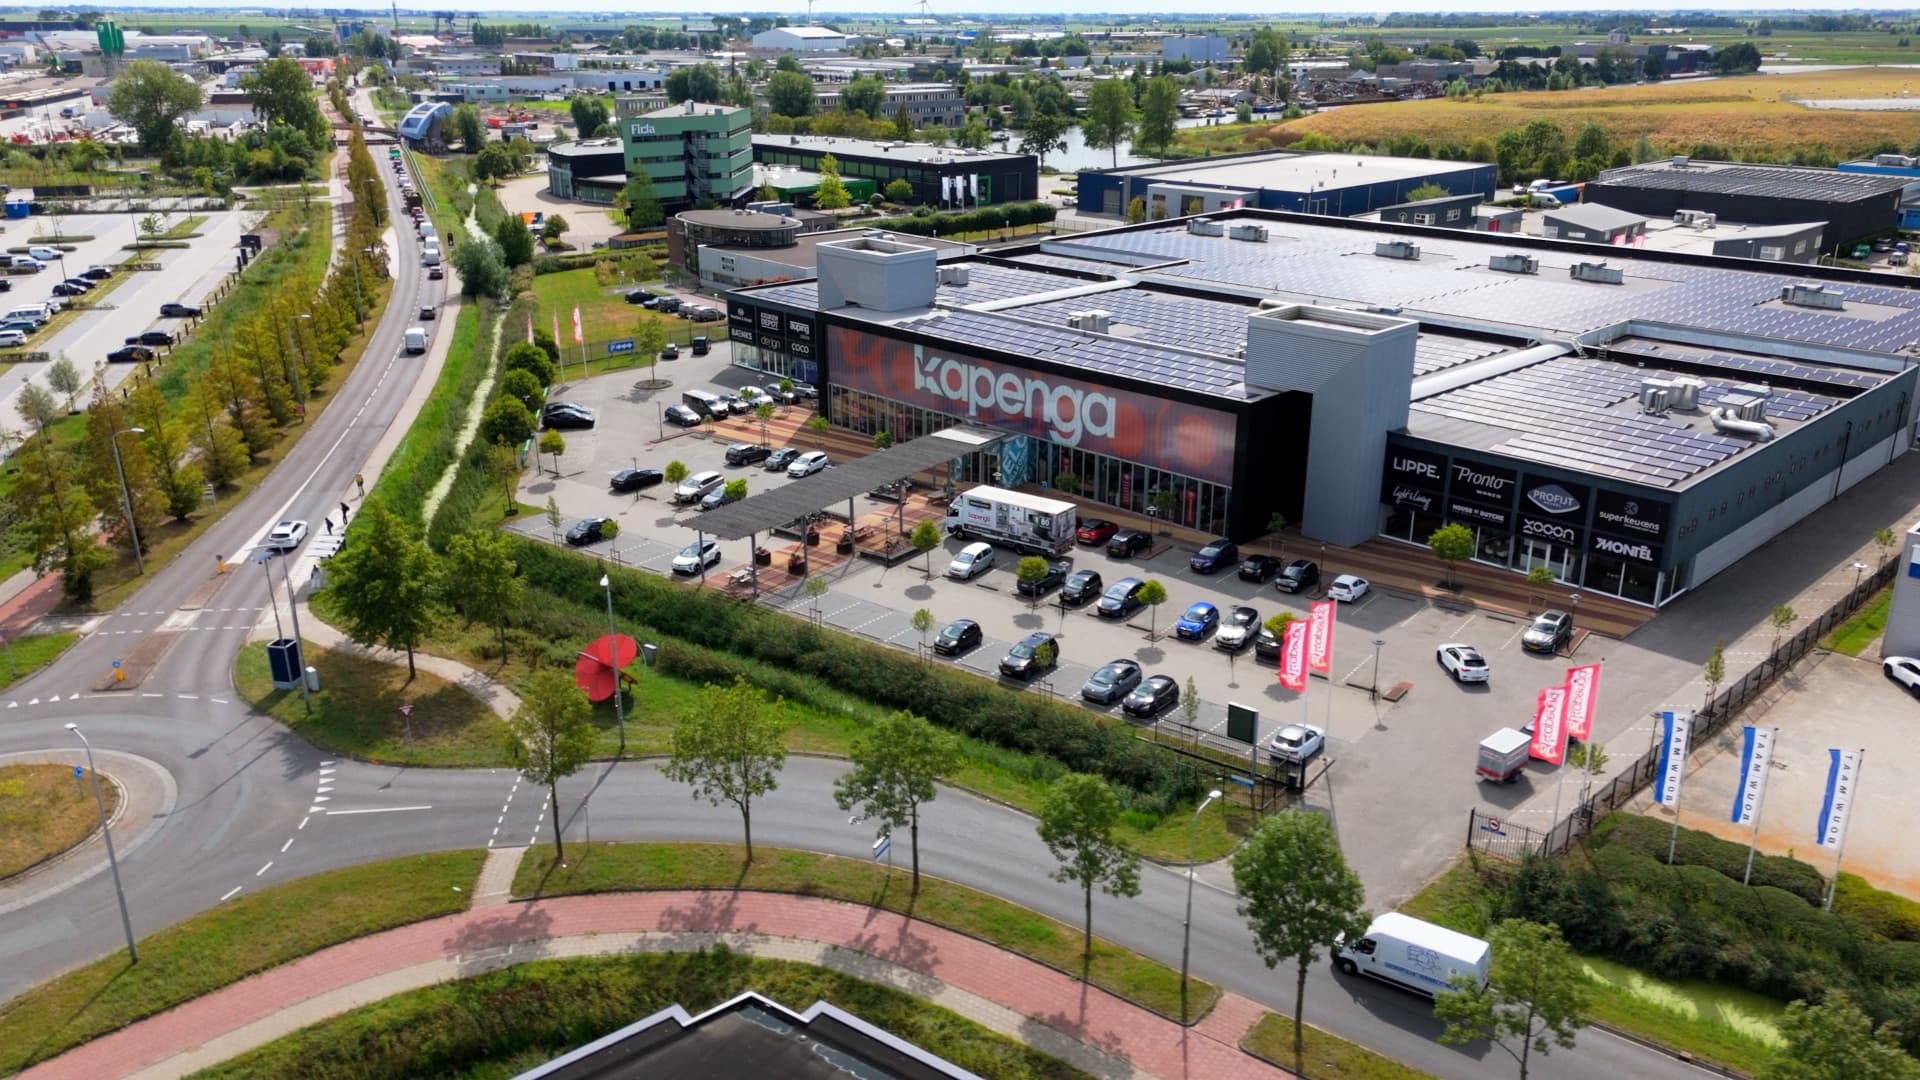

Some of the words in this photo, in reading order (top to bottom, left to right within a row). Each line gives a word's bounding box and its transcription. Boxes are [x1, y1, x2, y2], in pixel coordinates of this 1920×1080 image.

[761, 319, 778, 329] DEPOT
[914, 343, 1116, 447] kapenga
[1453, 465, 1514, 489] Pronto
[1533, 490, 1574, 506] PROFIJT
